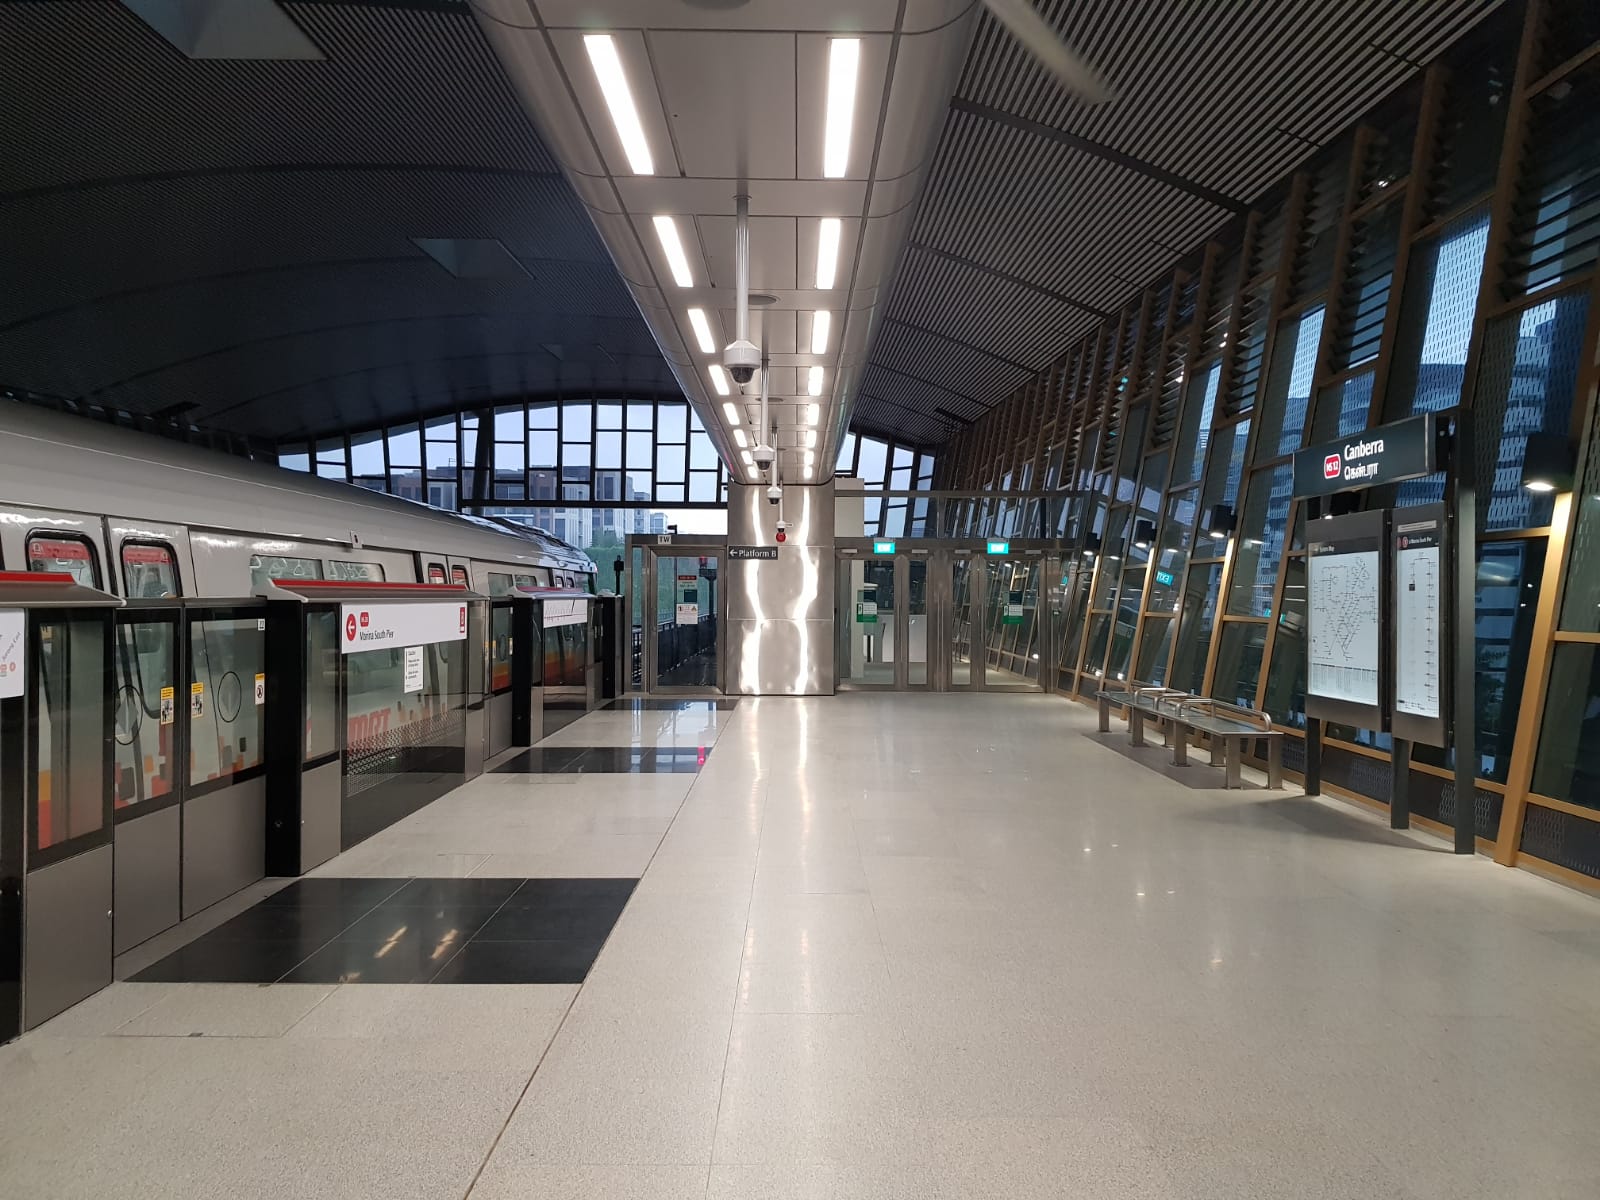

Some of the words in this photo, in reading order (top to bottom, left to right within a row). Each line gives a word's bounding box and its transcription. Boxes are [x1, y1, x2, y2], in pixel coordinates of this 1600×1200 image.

[1344, 440, 1384, 461] Canberra
[738, 548, 769, 557] Platform
[375, 630, 386, 639] South
